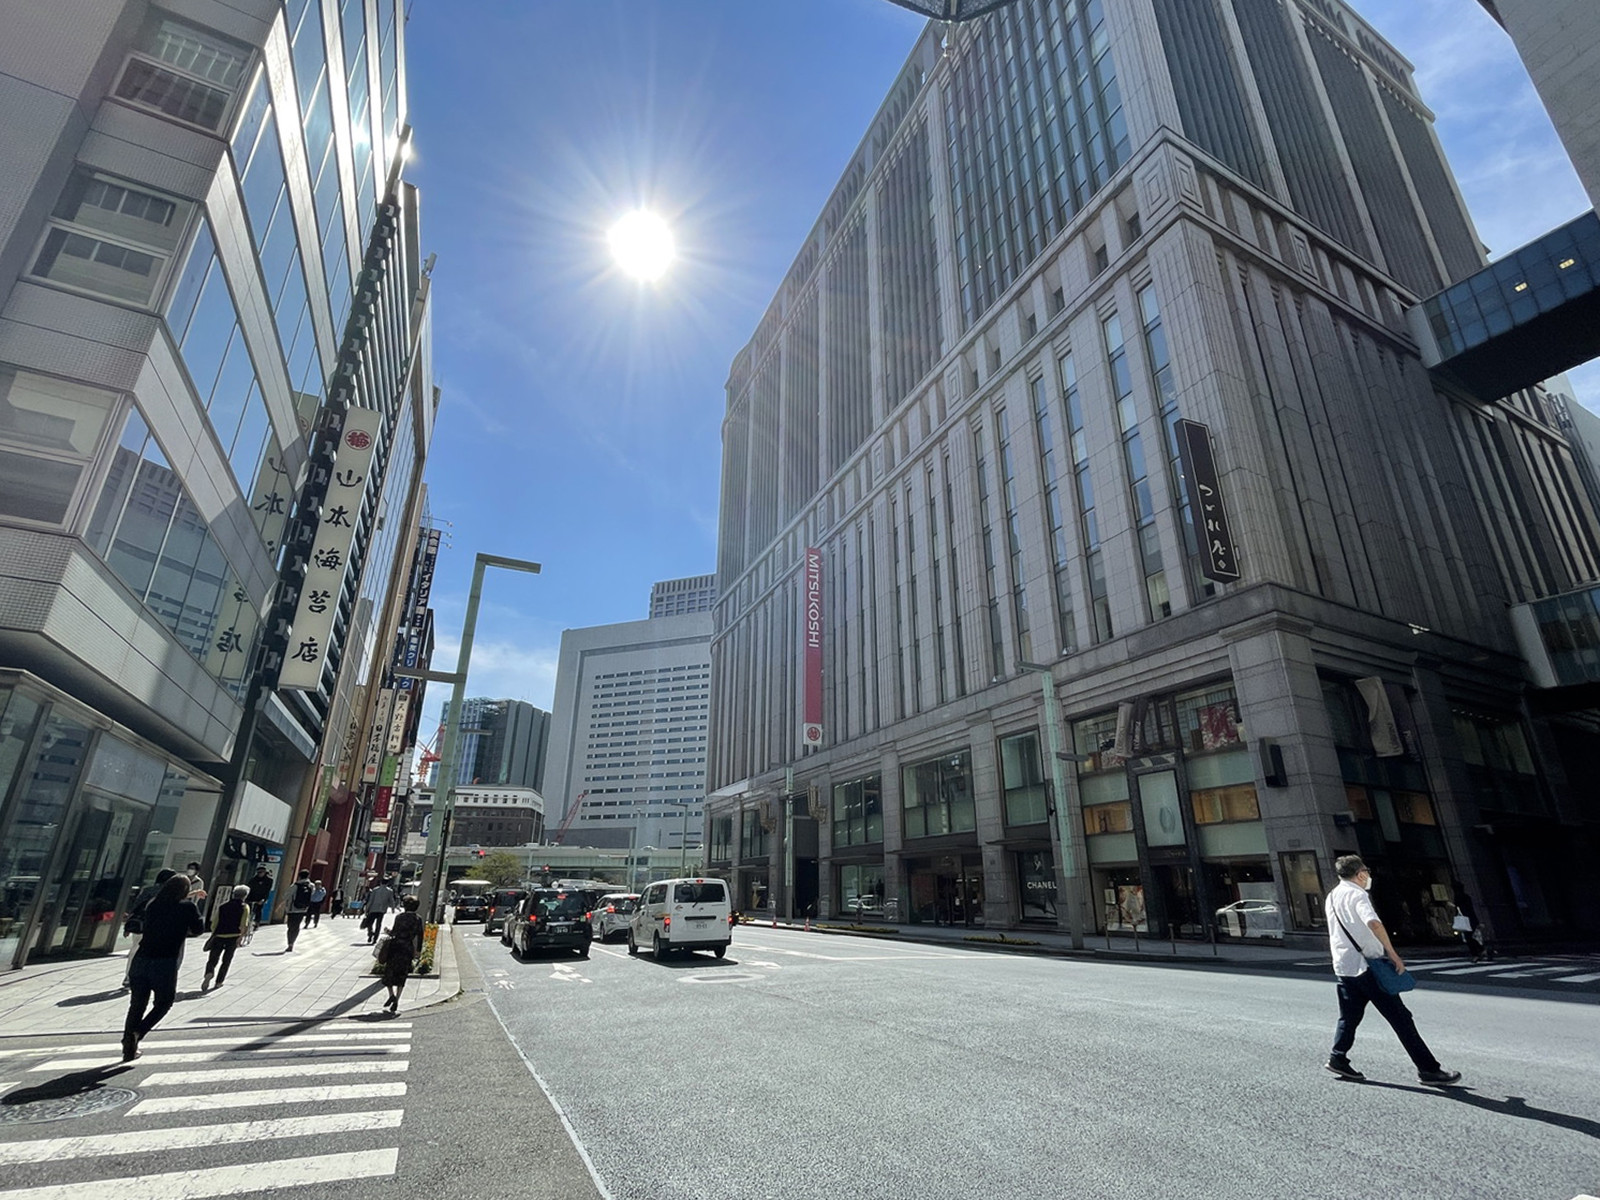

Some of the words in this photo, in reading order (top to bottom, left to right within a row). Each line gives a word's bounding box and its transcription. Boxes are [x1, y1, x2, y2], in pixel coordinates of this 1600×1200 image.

[291, 469, 363, 664] 山本海苔店
[808, 554, 820, 648] MITSUKOSHI
[1027, 881, 1057, 890] CHANEL
